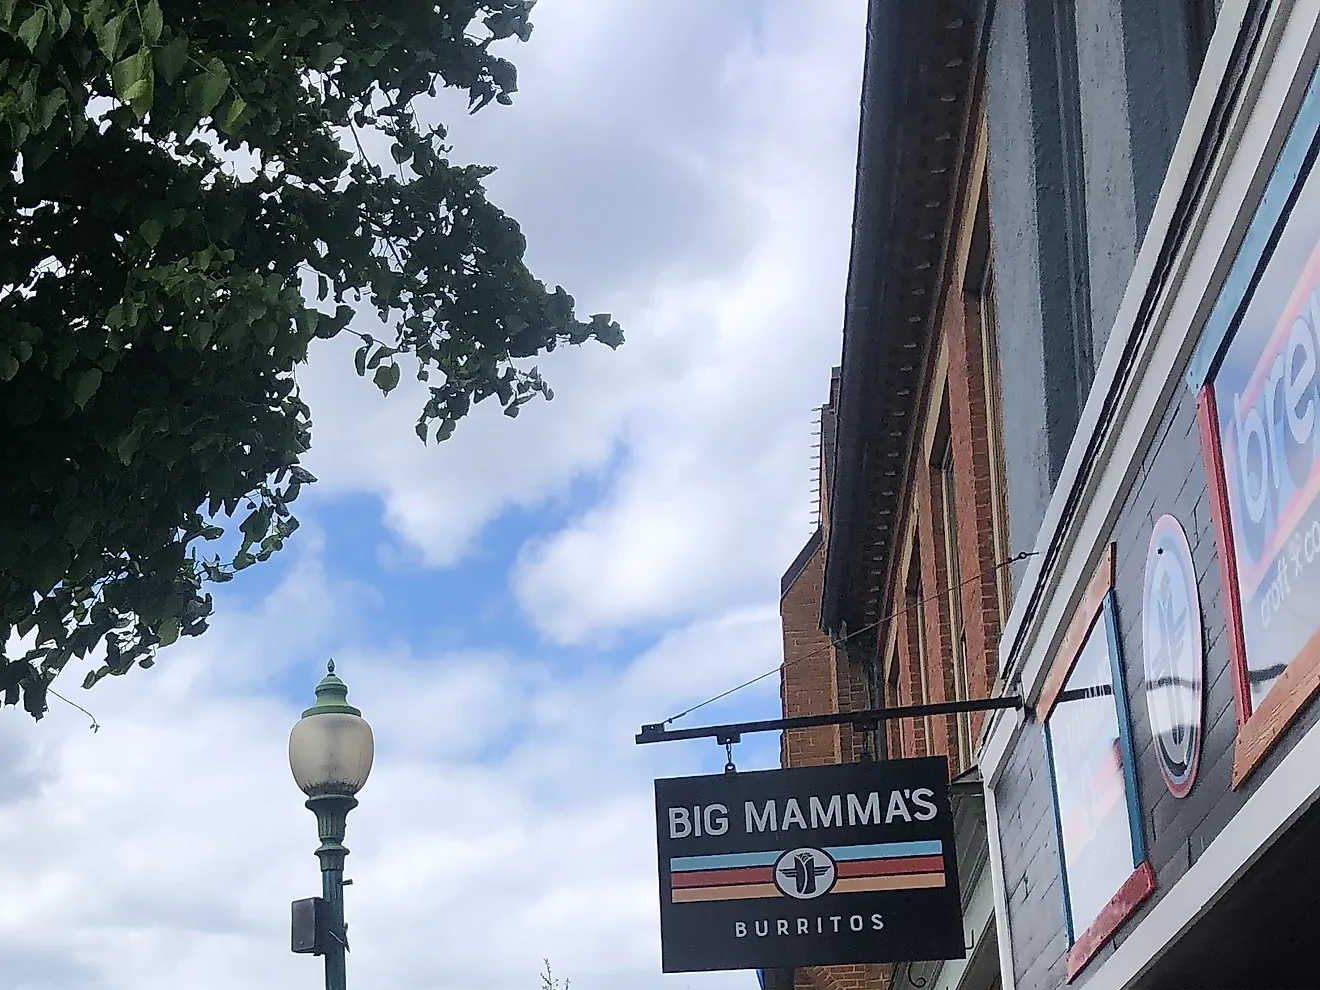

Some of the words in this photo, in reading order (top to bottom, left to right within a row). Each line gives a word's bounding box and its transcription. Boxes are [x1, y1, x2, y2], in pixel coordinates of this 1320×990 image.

[1260, 556, 1291, 628] craft
[1304, 519, 1320, 566] co
[668, 803, 730, 839] BIG
[744, 787, 938, 833] MAMMA'S
[735, 913, 886, 939] BURRITOS
